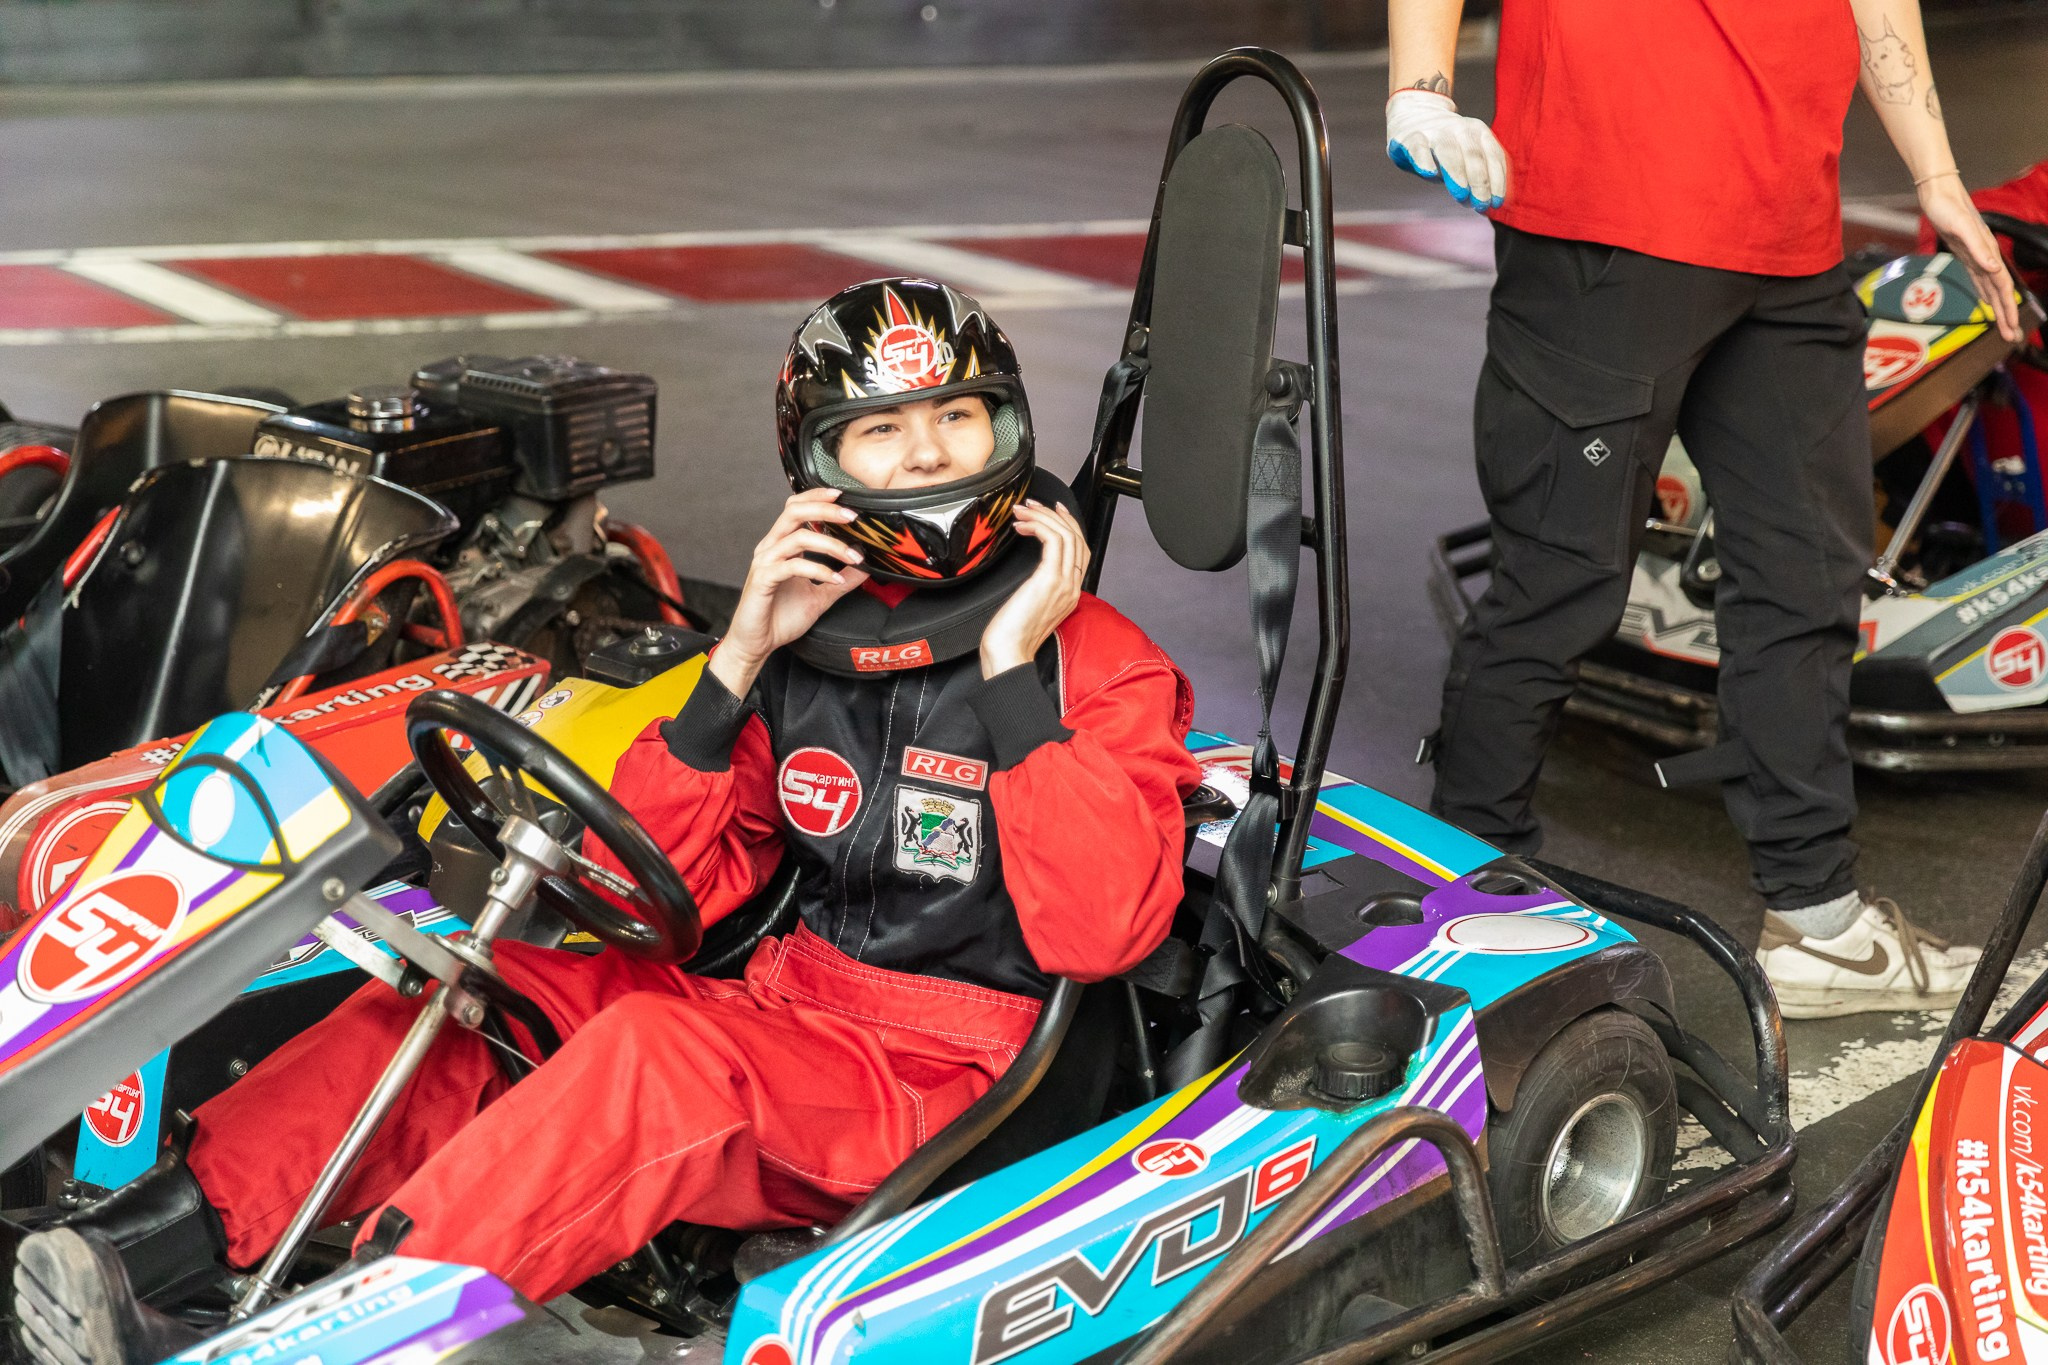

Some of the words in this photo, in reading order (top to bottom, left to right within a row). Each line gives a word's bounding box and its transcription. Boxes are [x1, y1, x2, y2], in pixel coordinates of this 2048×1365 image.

[858, 645, 922, 664] RLG
[911, 754, 978, 782] RLG
[1957, 1138, 2011, 1362] #k54karting
